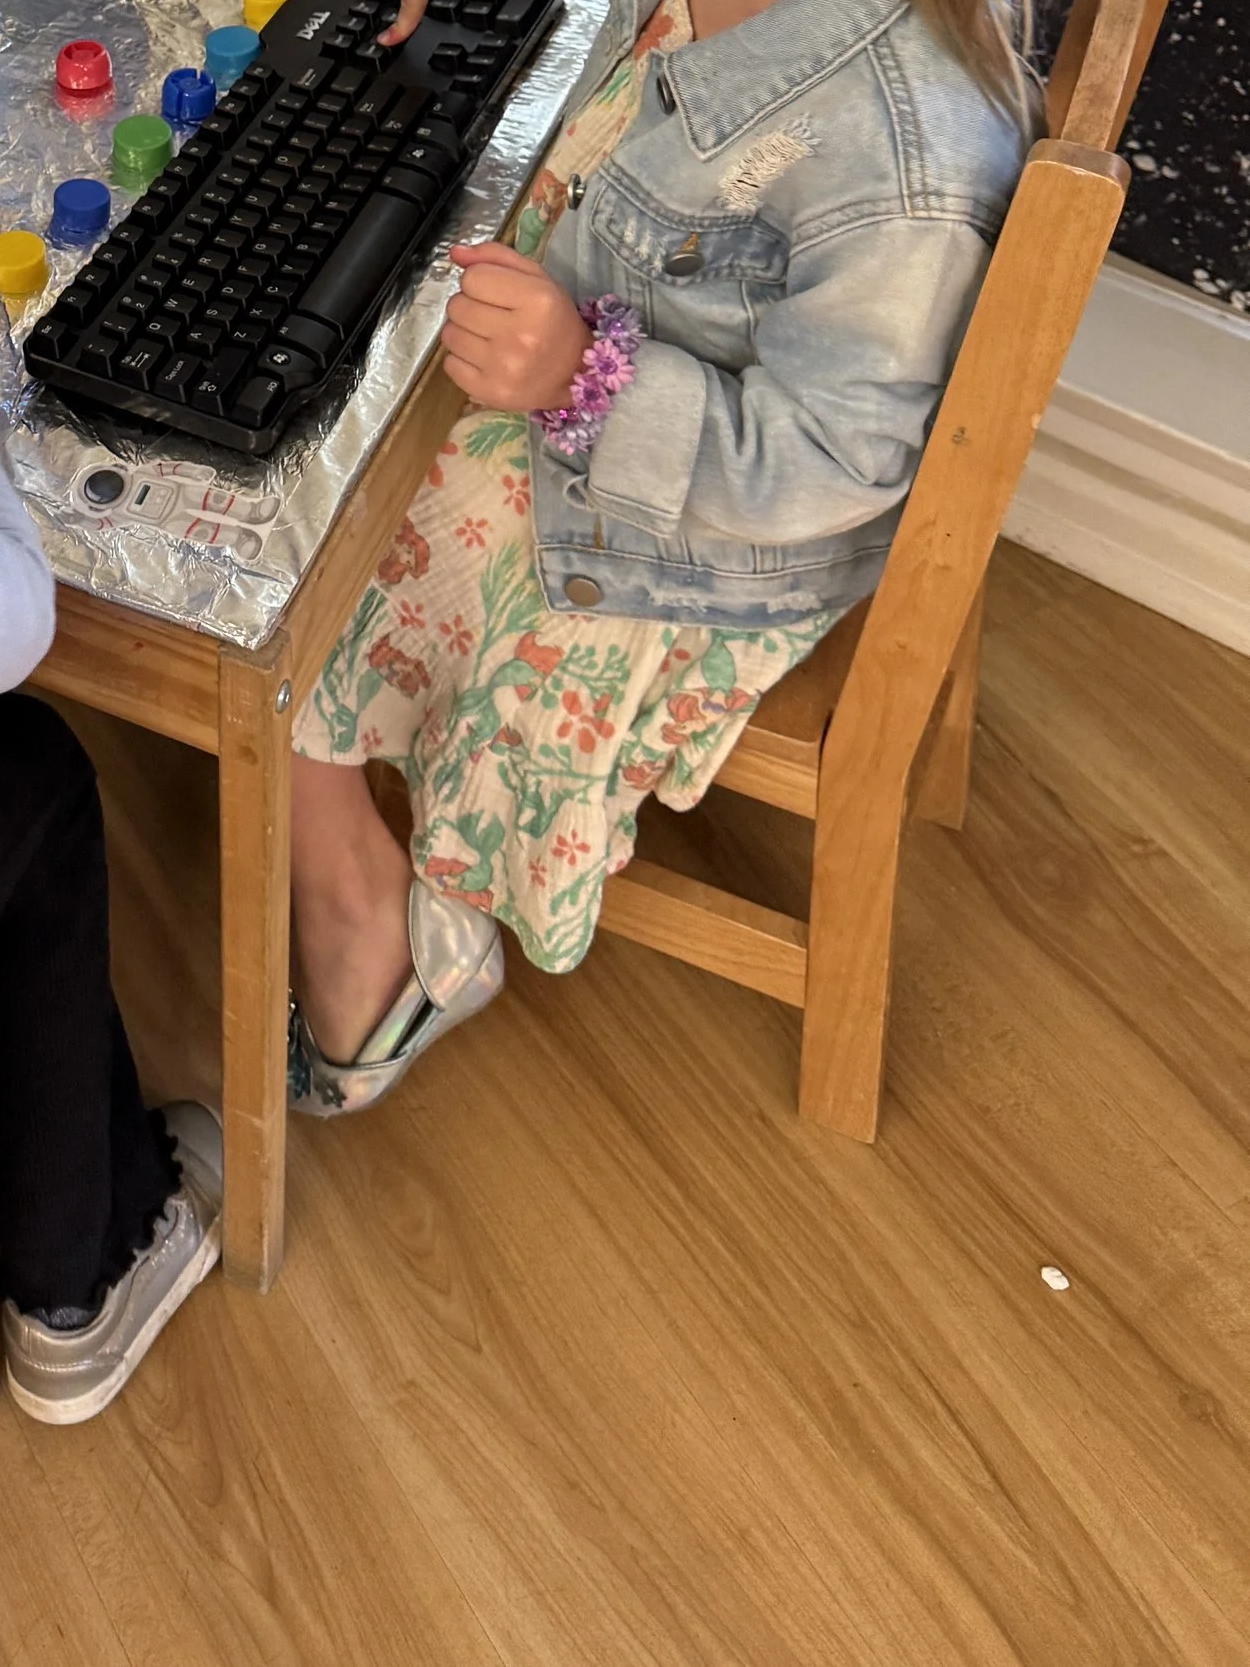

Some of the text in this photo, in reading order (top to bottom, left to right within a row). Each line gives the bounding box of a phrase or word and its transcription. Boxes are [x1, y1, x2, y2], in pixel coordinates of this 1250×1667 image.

[297, 11, 331, 41] DELL
[231, 214, 243, 223] Y
[268, 222, 281, 230] H
[254, 243, 267, 251] G
[199, 256, 212, 265] R
[238, 265, 247, 273] F
[282, 264, 294, 272] V
[183, 278, 195, 286] E
[222, 286, 234, 294] D
[267, 286, 279, 294] C
[164, 298, 178, 309] W
[206, 308, 218, 316] S
[250, 308, 262, 316] X
[149, 322, 161, 331] Q
[234, 331, 247, 339] Z
